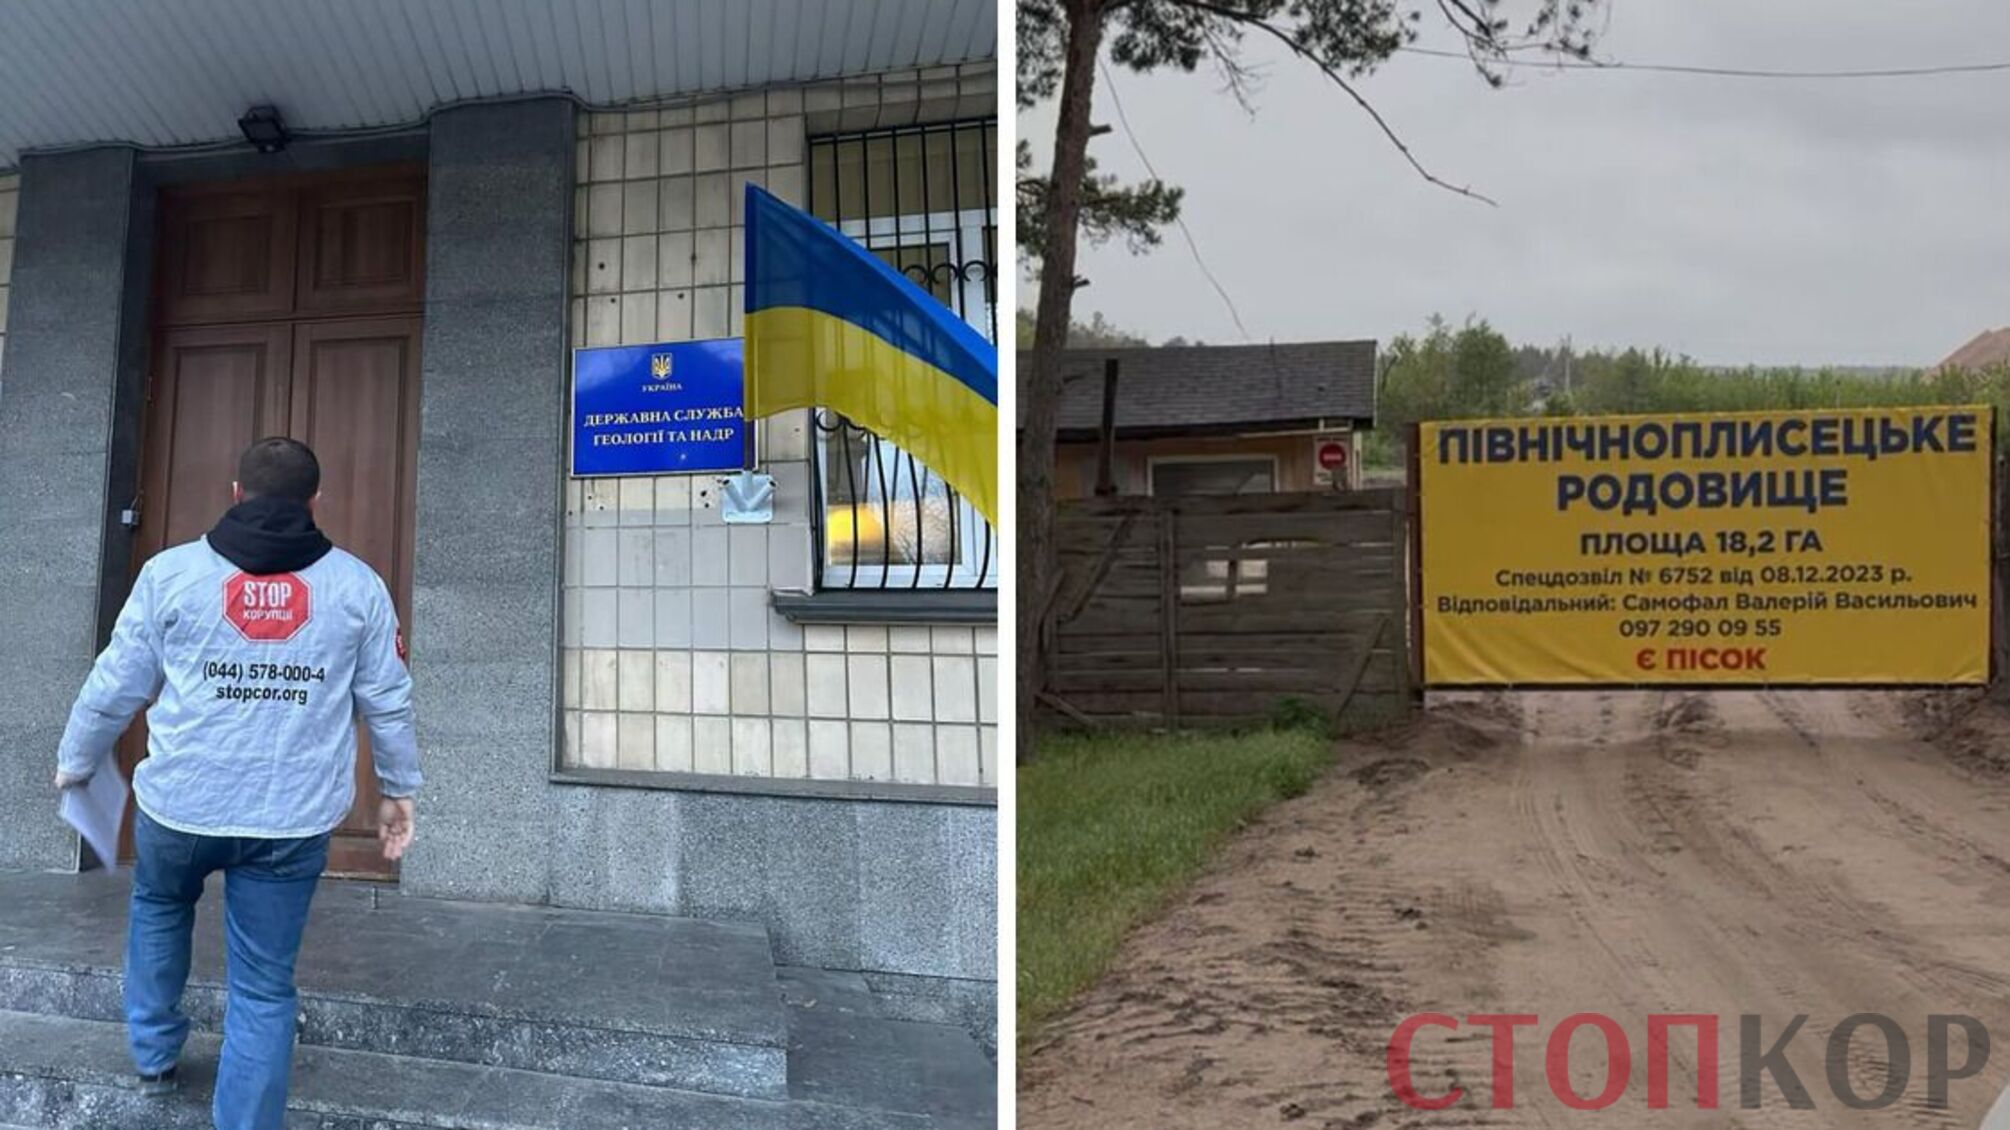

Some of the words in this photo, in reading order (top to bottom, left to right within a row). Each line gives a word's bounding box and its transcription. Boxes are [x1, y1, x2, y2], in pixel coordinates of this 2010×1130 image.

[642, 383, 682, 393] УКРАЇНА
[584, 411, 671, 427] ДЕРЖАВНА
[674, 406, 744, 422] СЛУЖБА
[593, 431, 664, 446] ГЕОЛОГІЇ
[667, 430, 687, 443] ТА
[690, 428, 734, 442] НАДР
[1439, 415, 1977, 464] ПІВНІЧНОПЛИСЕЦЬКЕ
[1557, 469, 1848, 516] РОДОВИЩЕ
[1580, 532, 1706, 557] ПЛОЩА
[1716, 531, 1775, 557] 18,2
[1785, 530, 1823, 552] ГА
[1496, 569, 1622, 587] Спецдозвіл
[1629, 568, 1652, 585] №
[1659, 567, 1713, 585] 6752
[1720, 568, 1754, 585] від
[1761, 565, 1883, 583] 08.12.2023
[1891, 568, 1912, 585] р.
[243, 581, 293, 607] STOP
[1437, 596, 1616, 614] Відповідальний:
[1622, 594, 1729, 612] Самофал
[1736, 592, 1828, 611] Валерій
[1835, 592, 1977, 609] Васильович
[1619, 620, 1661, 637] 097
[1668, 619, 1711, 637] 290
[1718, 618, 1748, 636] 09
[1755, 618, 1782, 636] 55
[1636, 649, 1656, 670] Є
[1667, 648, 1767, 670] ПІСОК
[203, 661, 243, 682] (044)
[249, 664, 325, 682] 578-000-4
[216, 685, 308, 705] stopcor.org
